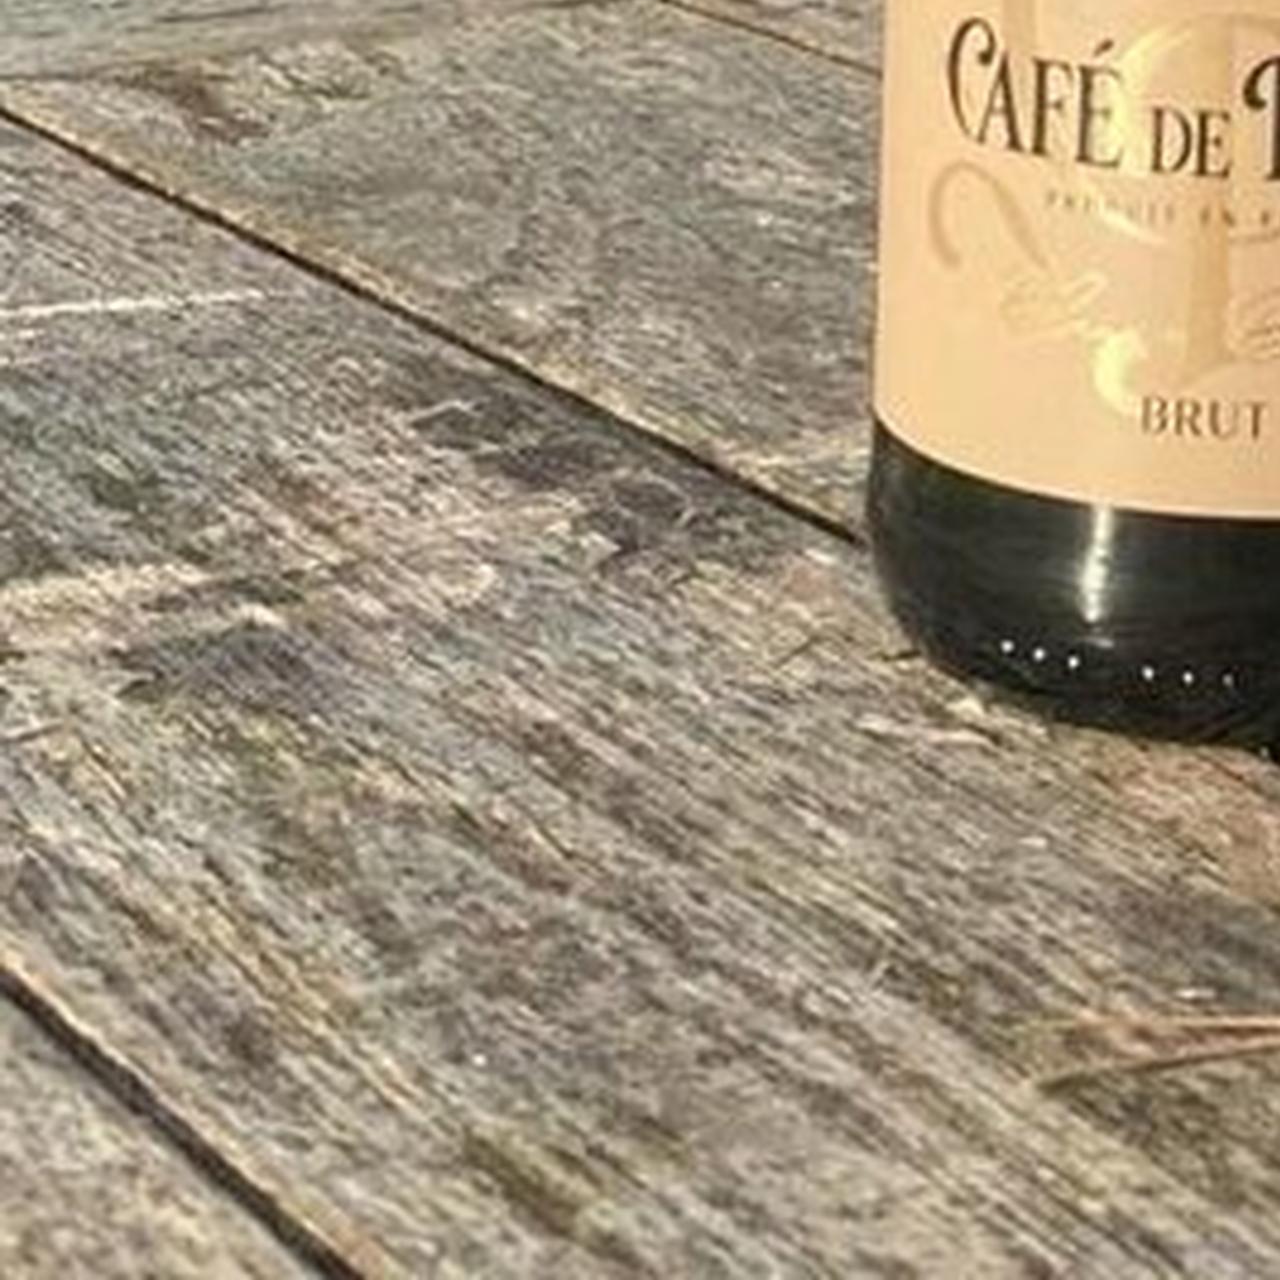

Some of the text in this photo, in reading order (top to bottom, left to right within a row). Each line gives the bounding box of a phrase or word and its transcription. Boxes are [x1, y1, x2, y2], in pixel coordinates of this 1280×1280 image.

[945, 15, 1122, 172] CAFÉ
[1150, 106, 1232, 180] DE
[1140, 394, 1270, 442] BRUT
